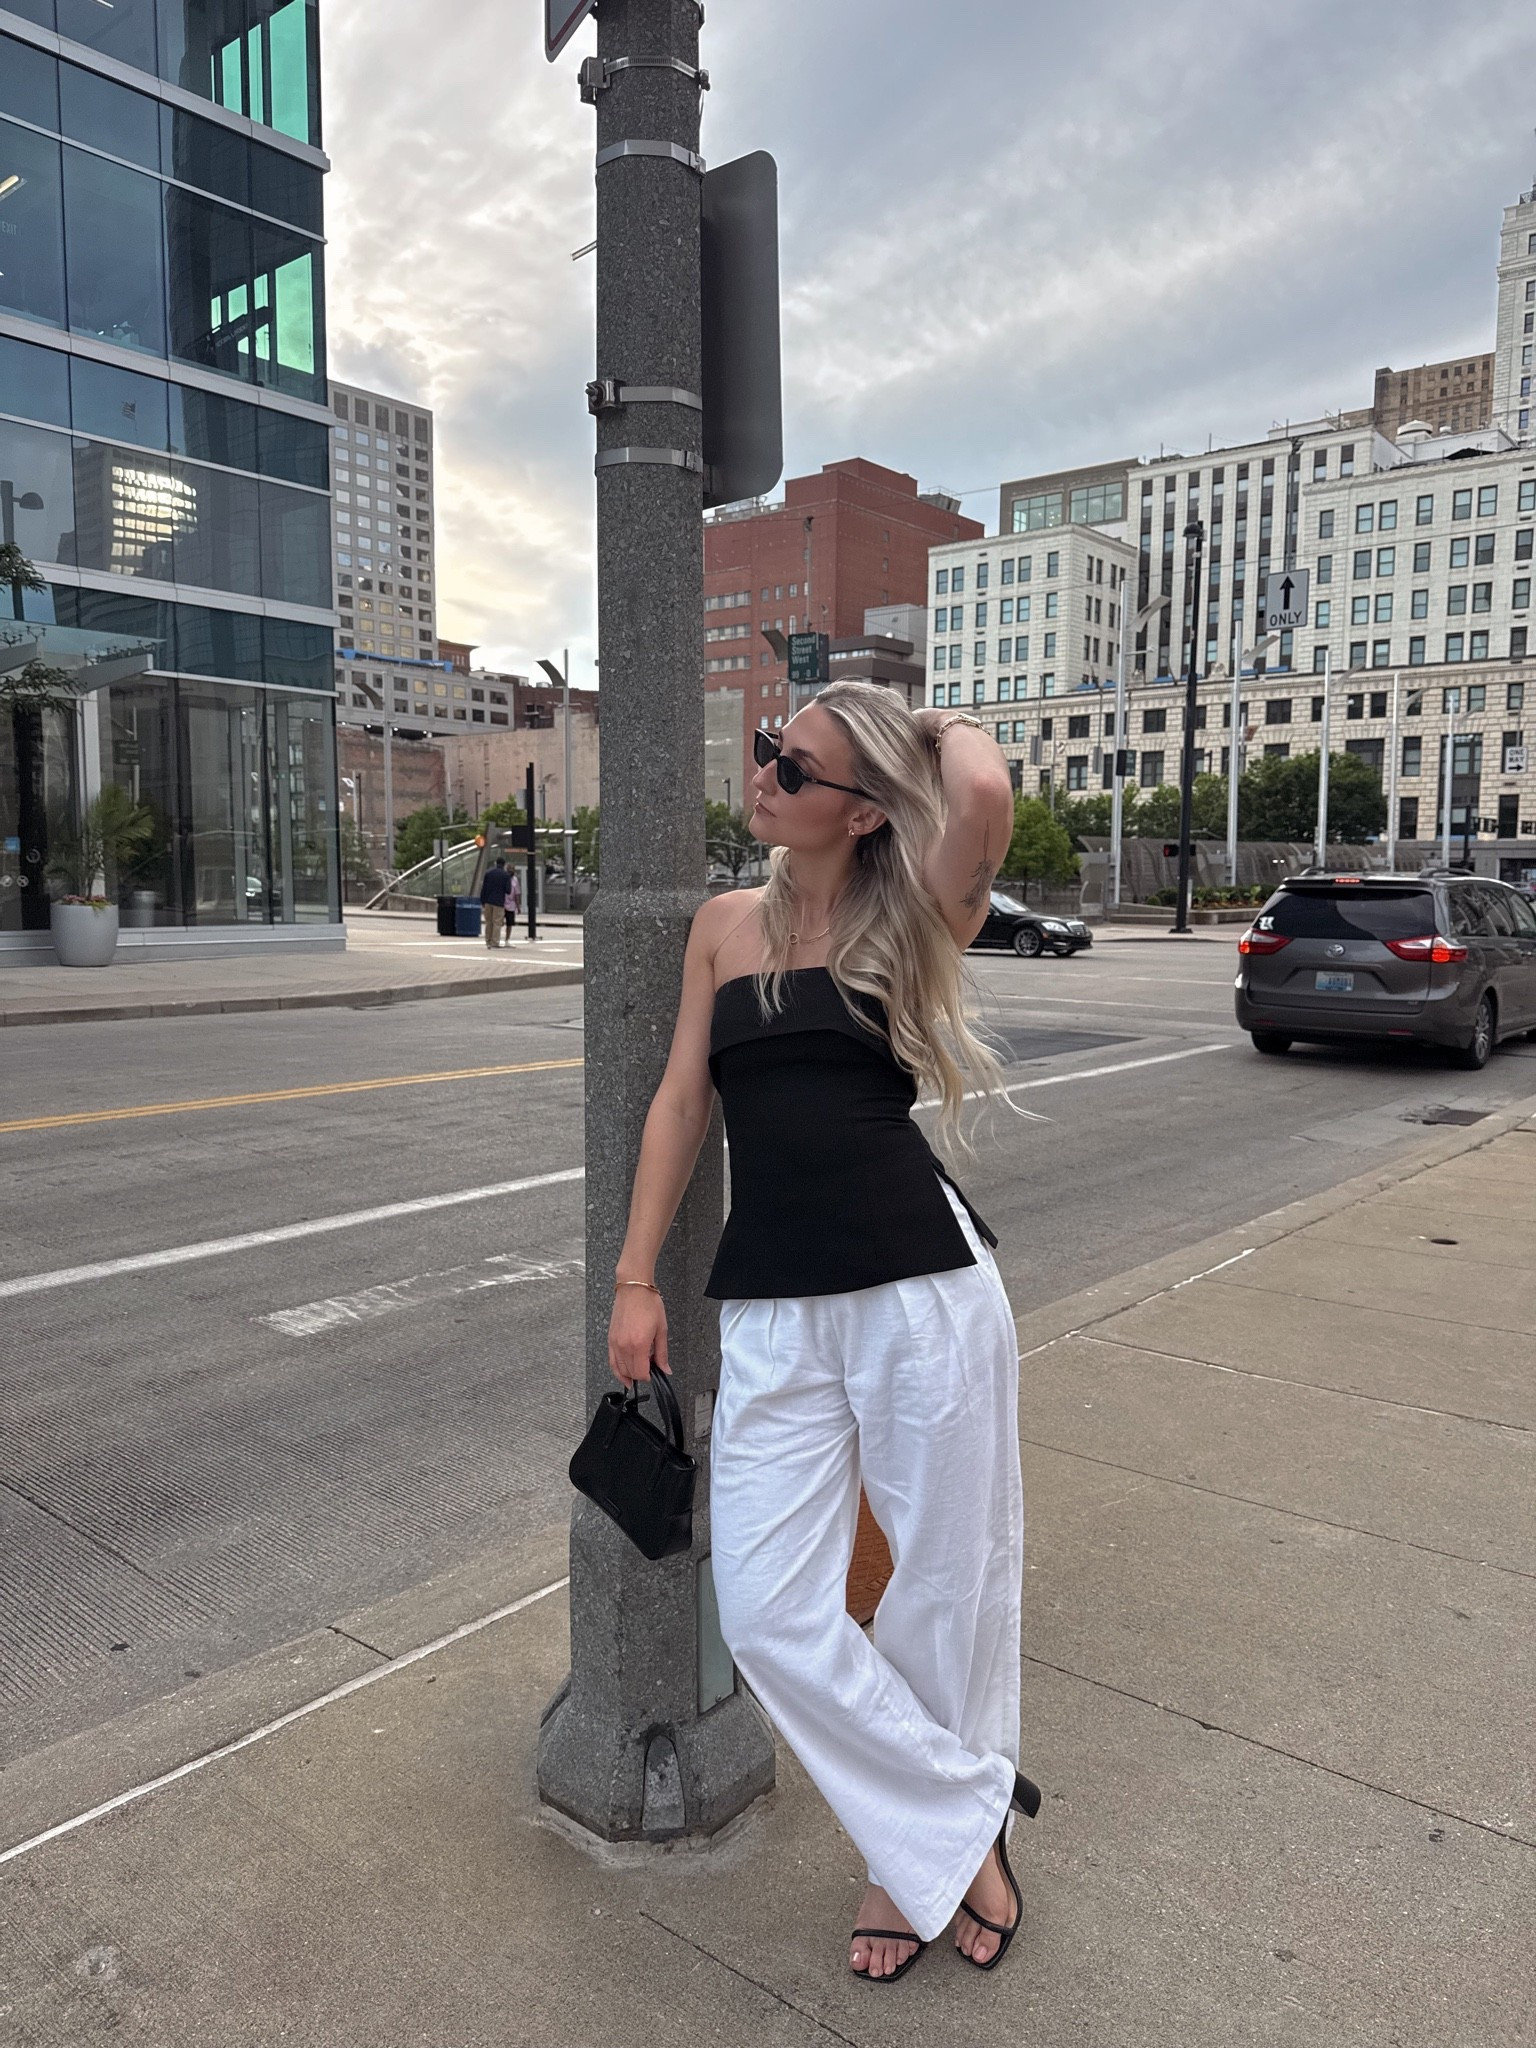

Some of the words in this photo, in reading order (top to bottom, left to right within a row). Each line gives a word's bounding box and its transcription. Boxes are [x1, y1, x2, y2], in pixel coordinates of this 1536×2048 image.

[1, 221, 17, 235] EXIT
[1270, 611, 1302, 626] ONLY
[791, 635, 816, 646] Second
[791, 646, 812, 656] Street
[791, 656, 809, 665] West
